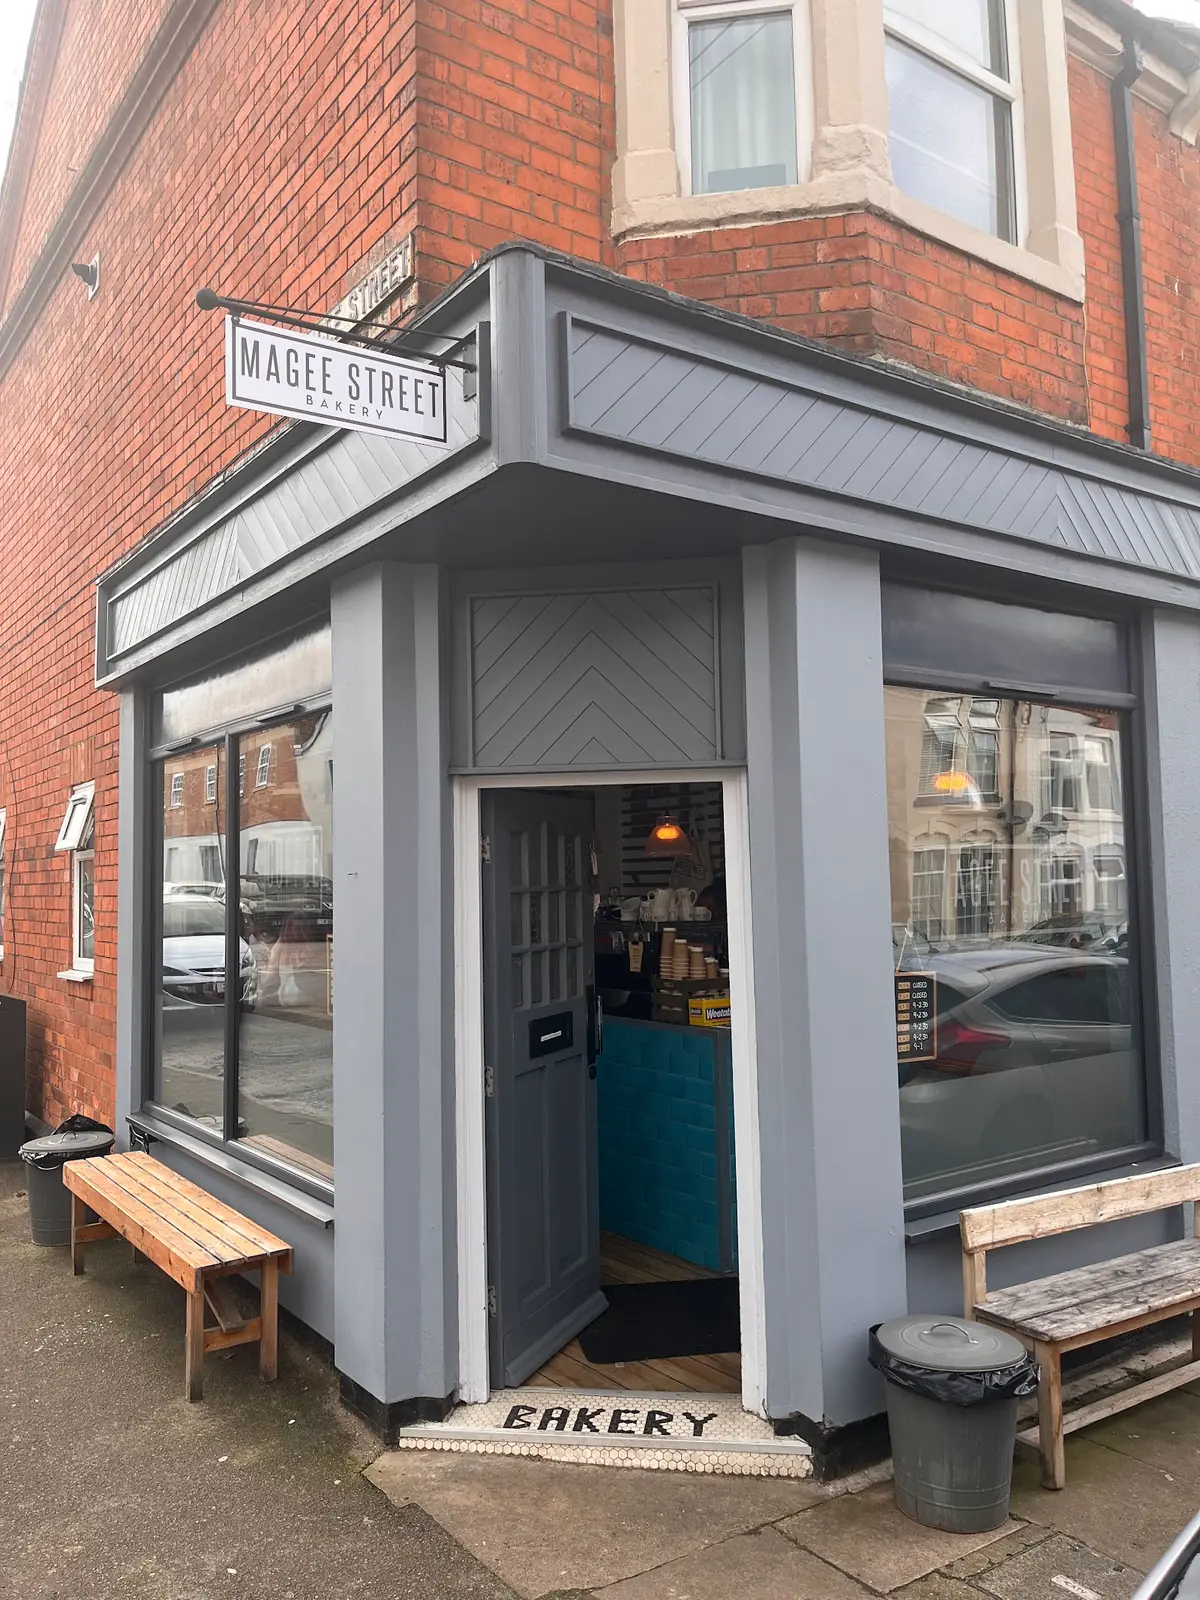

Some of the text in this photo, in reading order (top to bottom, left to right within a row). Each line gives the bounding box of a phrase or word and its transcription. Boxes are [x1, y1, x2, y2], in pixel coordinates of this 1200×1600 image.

[348, 242, 410, 320] STREET
[240, 336, 439, 418] MAGEE STREET
[306, 394, 383, 420] BAKERY
[912, 991, 928, 999] CLOSED
[502, 1404, 719, 1438] BAKERY
